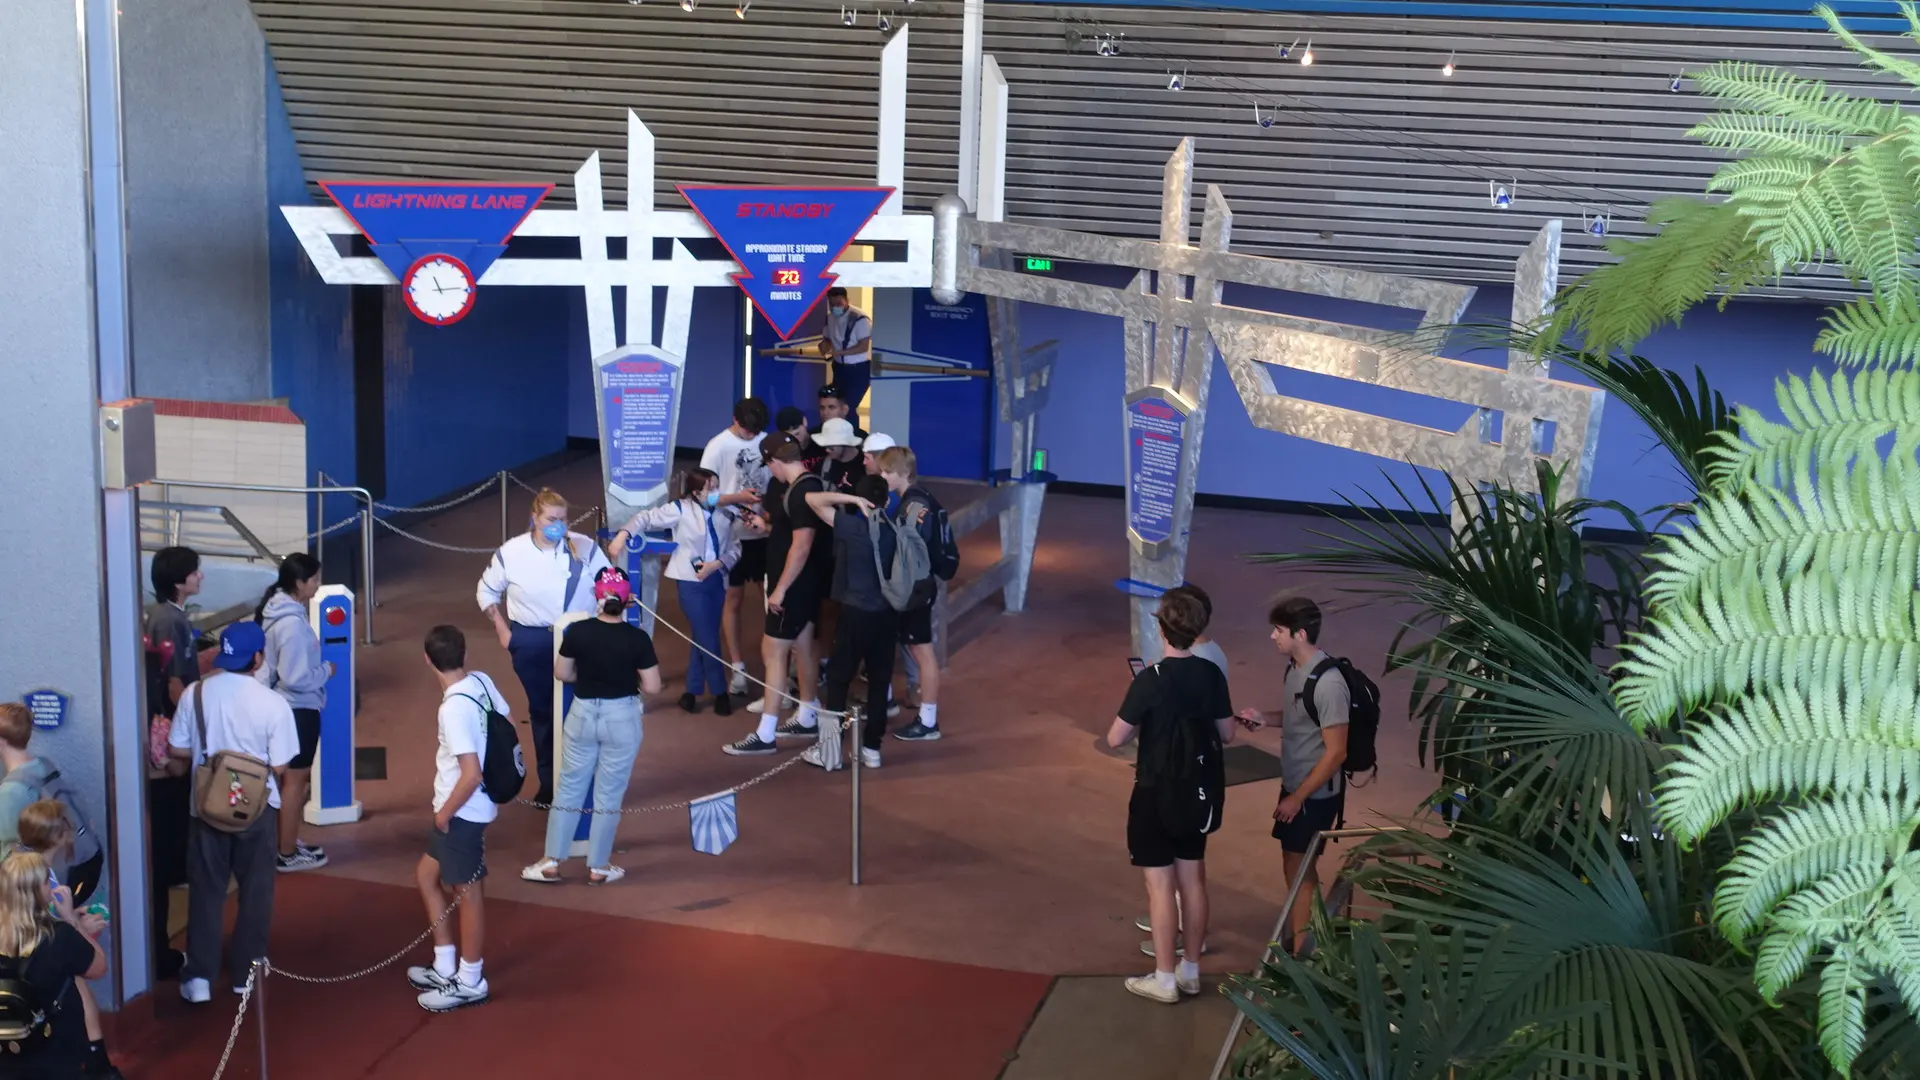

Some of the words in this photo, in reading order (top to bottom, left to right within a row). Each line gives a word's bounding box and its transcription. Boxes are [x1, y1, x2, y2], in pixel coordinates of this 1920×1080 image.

[353, 193, 468, 209] LIGHTNING
[471, 194, 528, 209] LANE
[736, 203, 836, 218] STANDBY
[745, 244, 795, 254] APPROXIMATE
[796, 244, 828, 254] STANDBY
[767, 254, 787, 263] WAIT
[788, 254, 806, 263] TIME
[778, 270, 800, 285] 70
[770, 291, 802, 300] MINUTES
